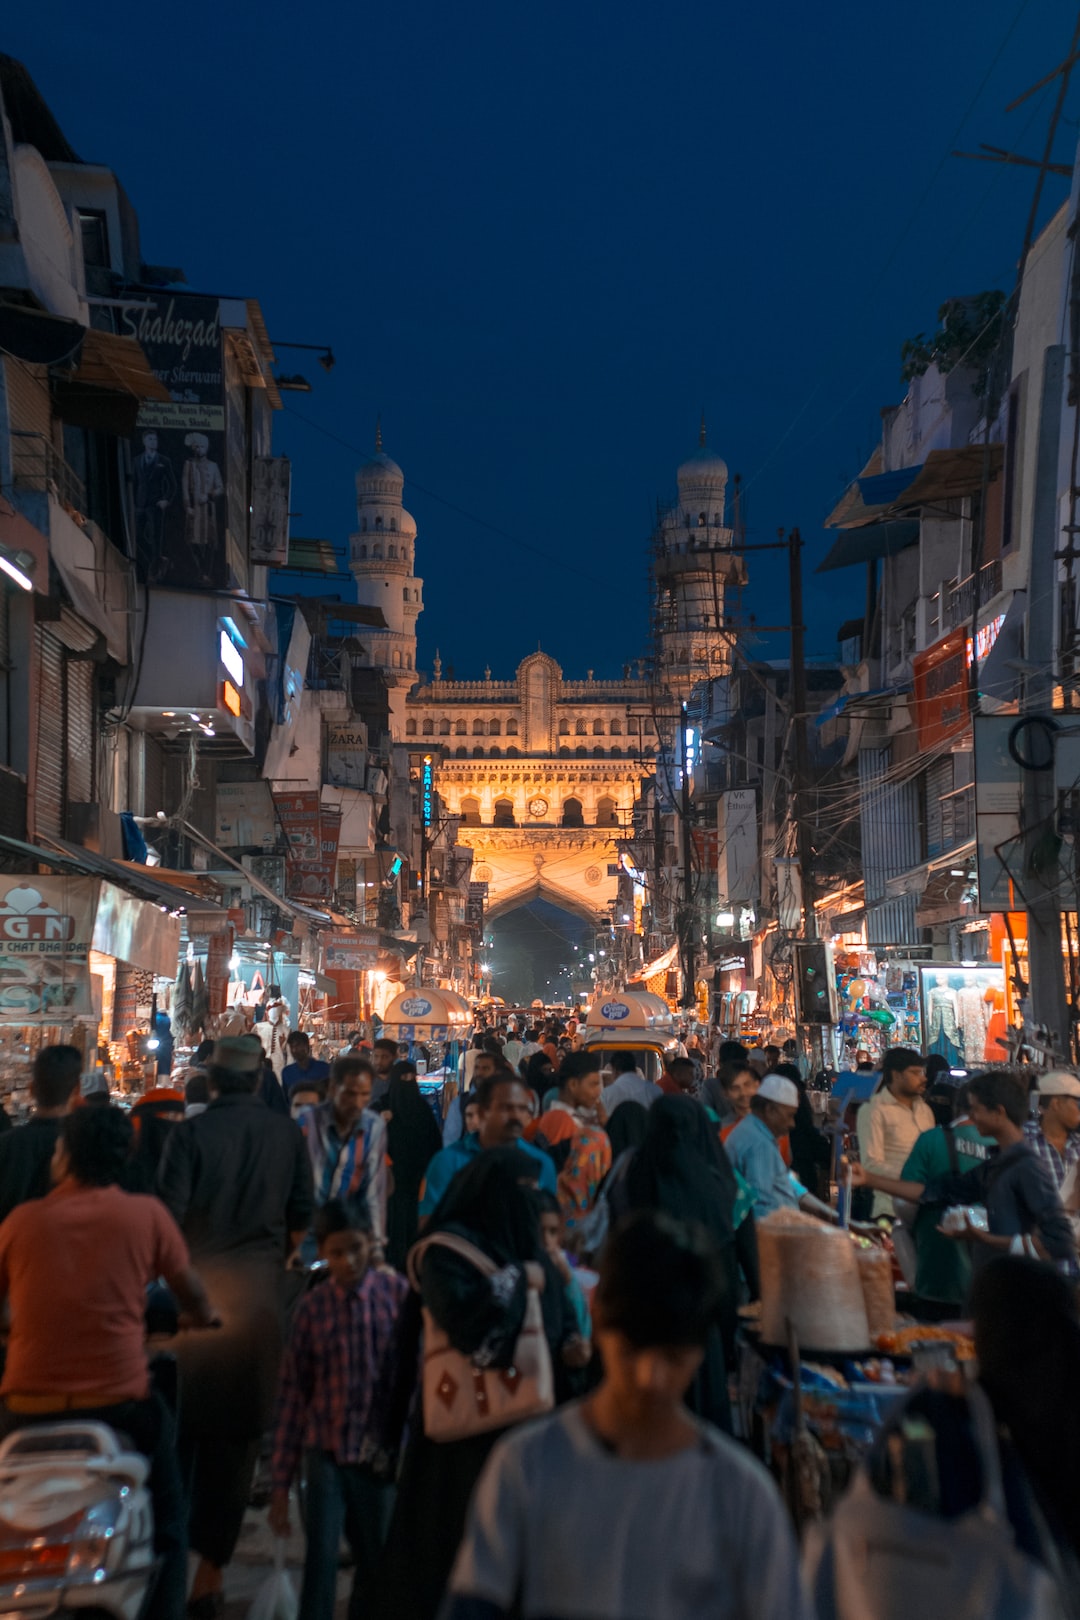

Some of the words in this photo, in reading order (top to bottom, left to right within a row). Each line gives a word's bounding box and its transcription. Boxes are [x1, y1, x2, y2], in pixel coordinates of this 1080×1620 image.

[121, 297, 220, 361] Shahezad
[172, 365, 221, 385] Sherwani
[330, 734, 363, 745] ZARA
[423, 765, 432, 790] SAMI
[733, 791, 745, 799] VK
[728, 802, 753, 811] Ethnic
[7, 942, 35, 952] CHAT
